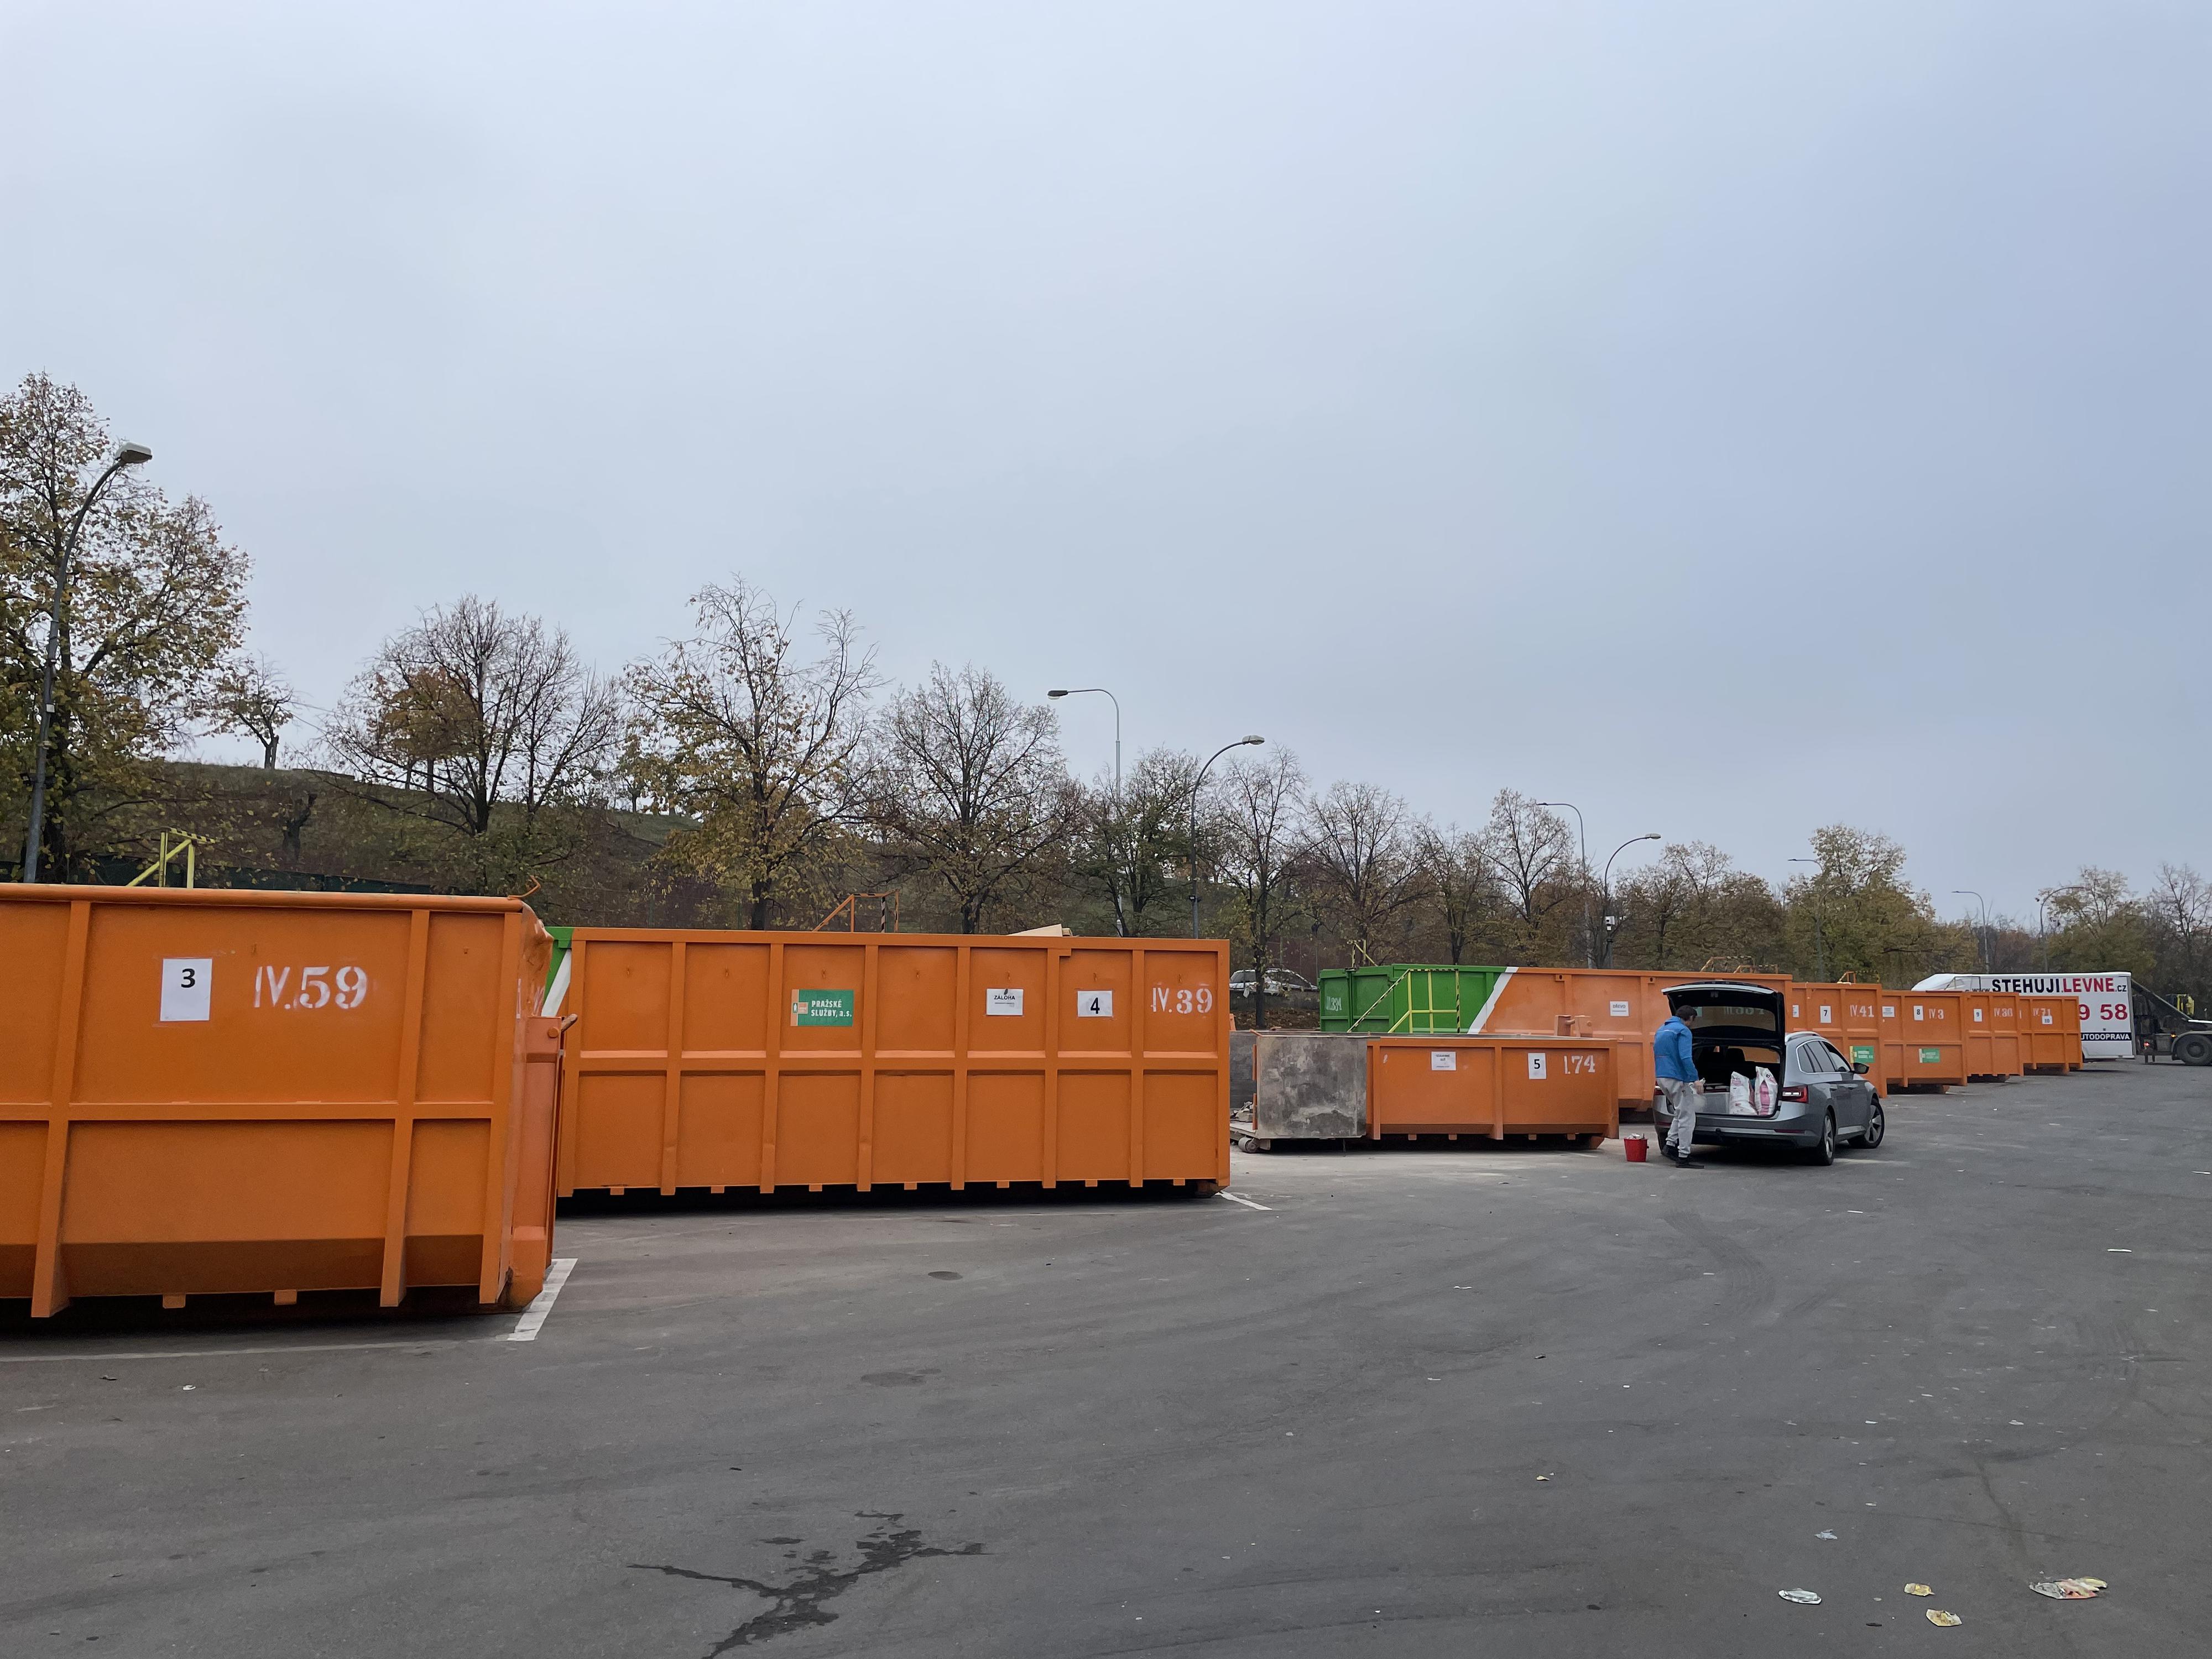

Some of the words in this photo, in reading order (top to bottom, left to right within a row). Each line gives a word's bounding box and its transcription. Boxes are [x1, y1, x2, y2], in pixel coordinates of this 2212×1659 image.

[181, 968, 196, 988] 3
[253, 966, 368, 1009] IV.59
[811, 999, 842, 1008] PRAŽSKÉ
[1090, 997, 1100, 1014] 4
[1152, 987, 1213, 1014] IV.39
[2100, 1003, 2128, 1020] 58
[1534, 1058, 1541, 1070] 5
